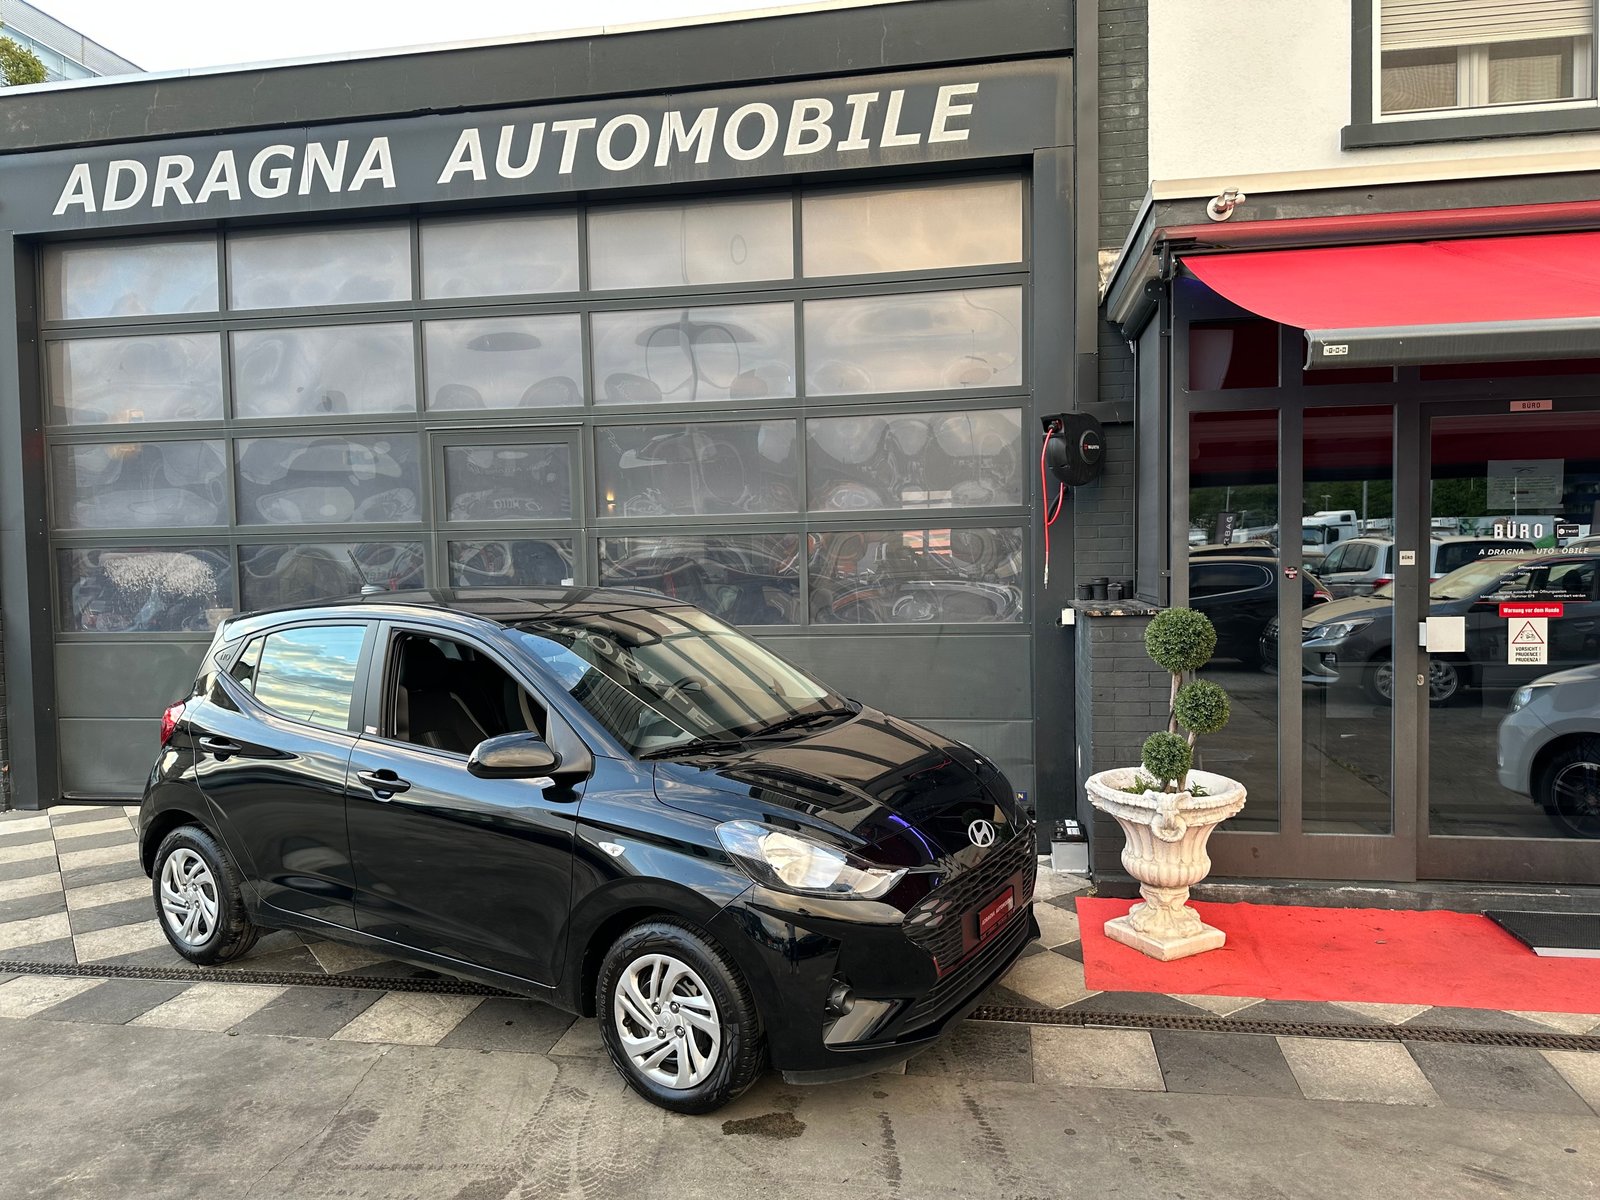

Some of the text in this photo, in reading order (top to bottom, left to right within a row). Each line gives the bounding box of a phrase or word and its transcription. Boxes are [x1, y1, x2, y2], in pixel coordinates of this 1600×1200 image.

[52, 82, 979, 216] ADRAGNA AUTOMOBILE
[1521, 401, 1541, 409] BÜRO
[1494, 521, 1543, 539] BÜRO
